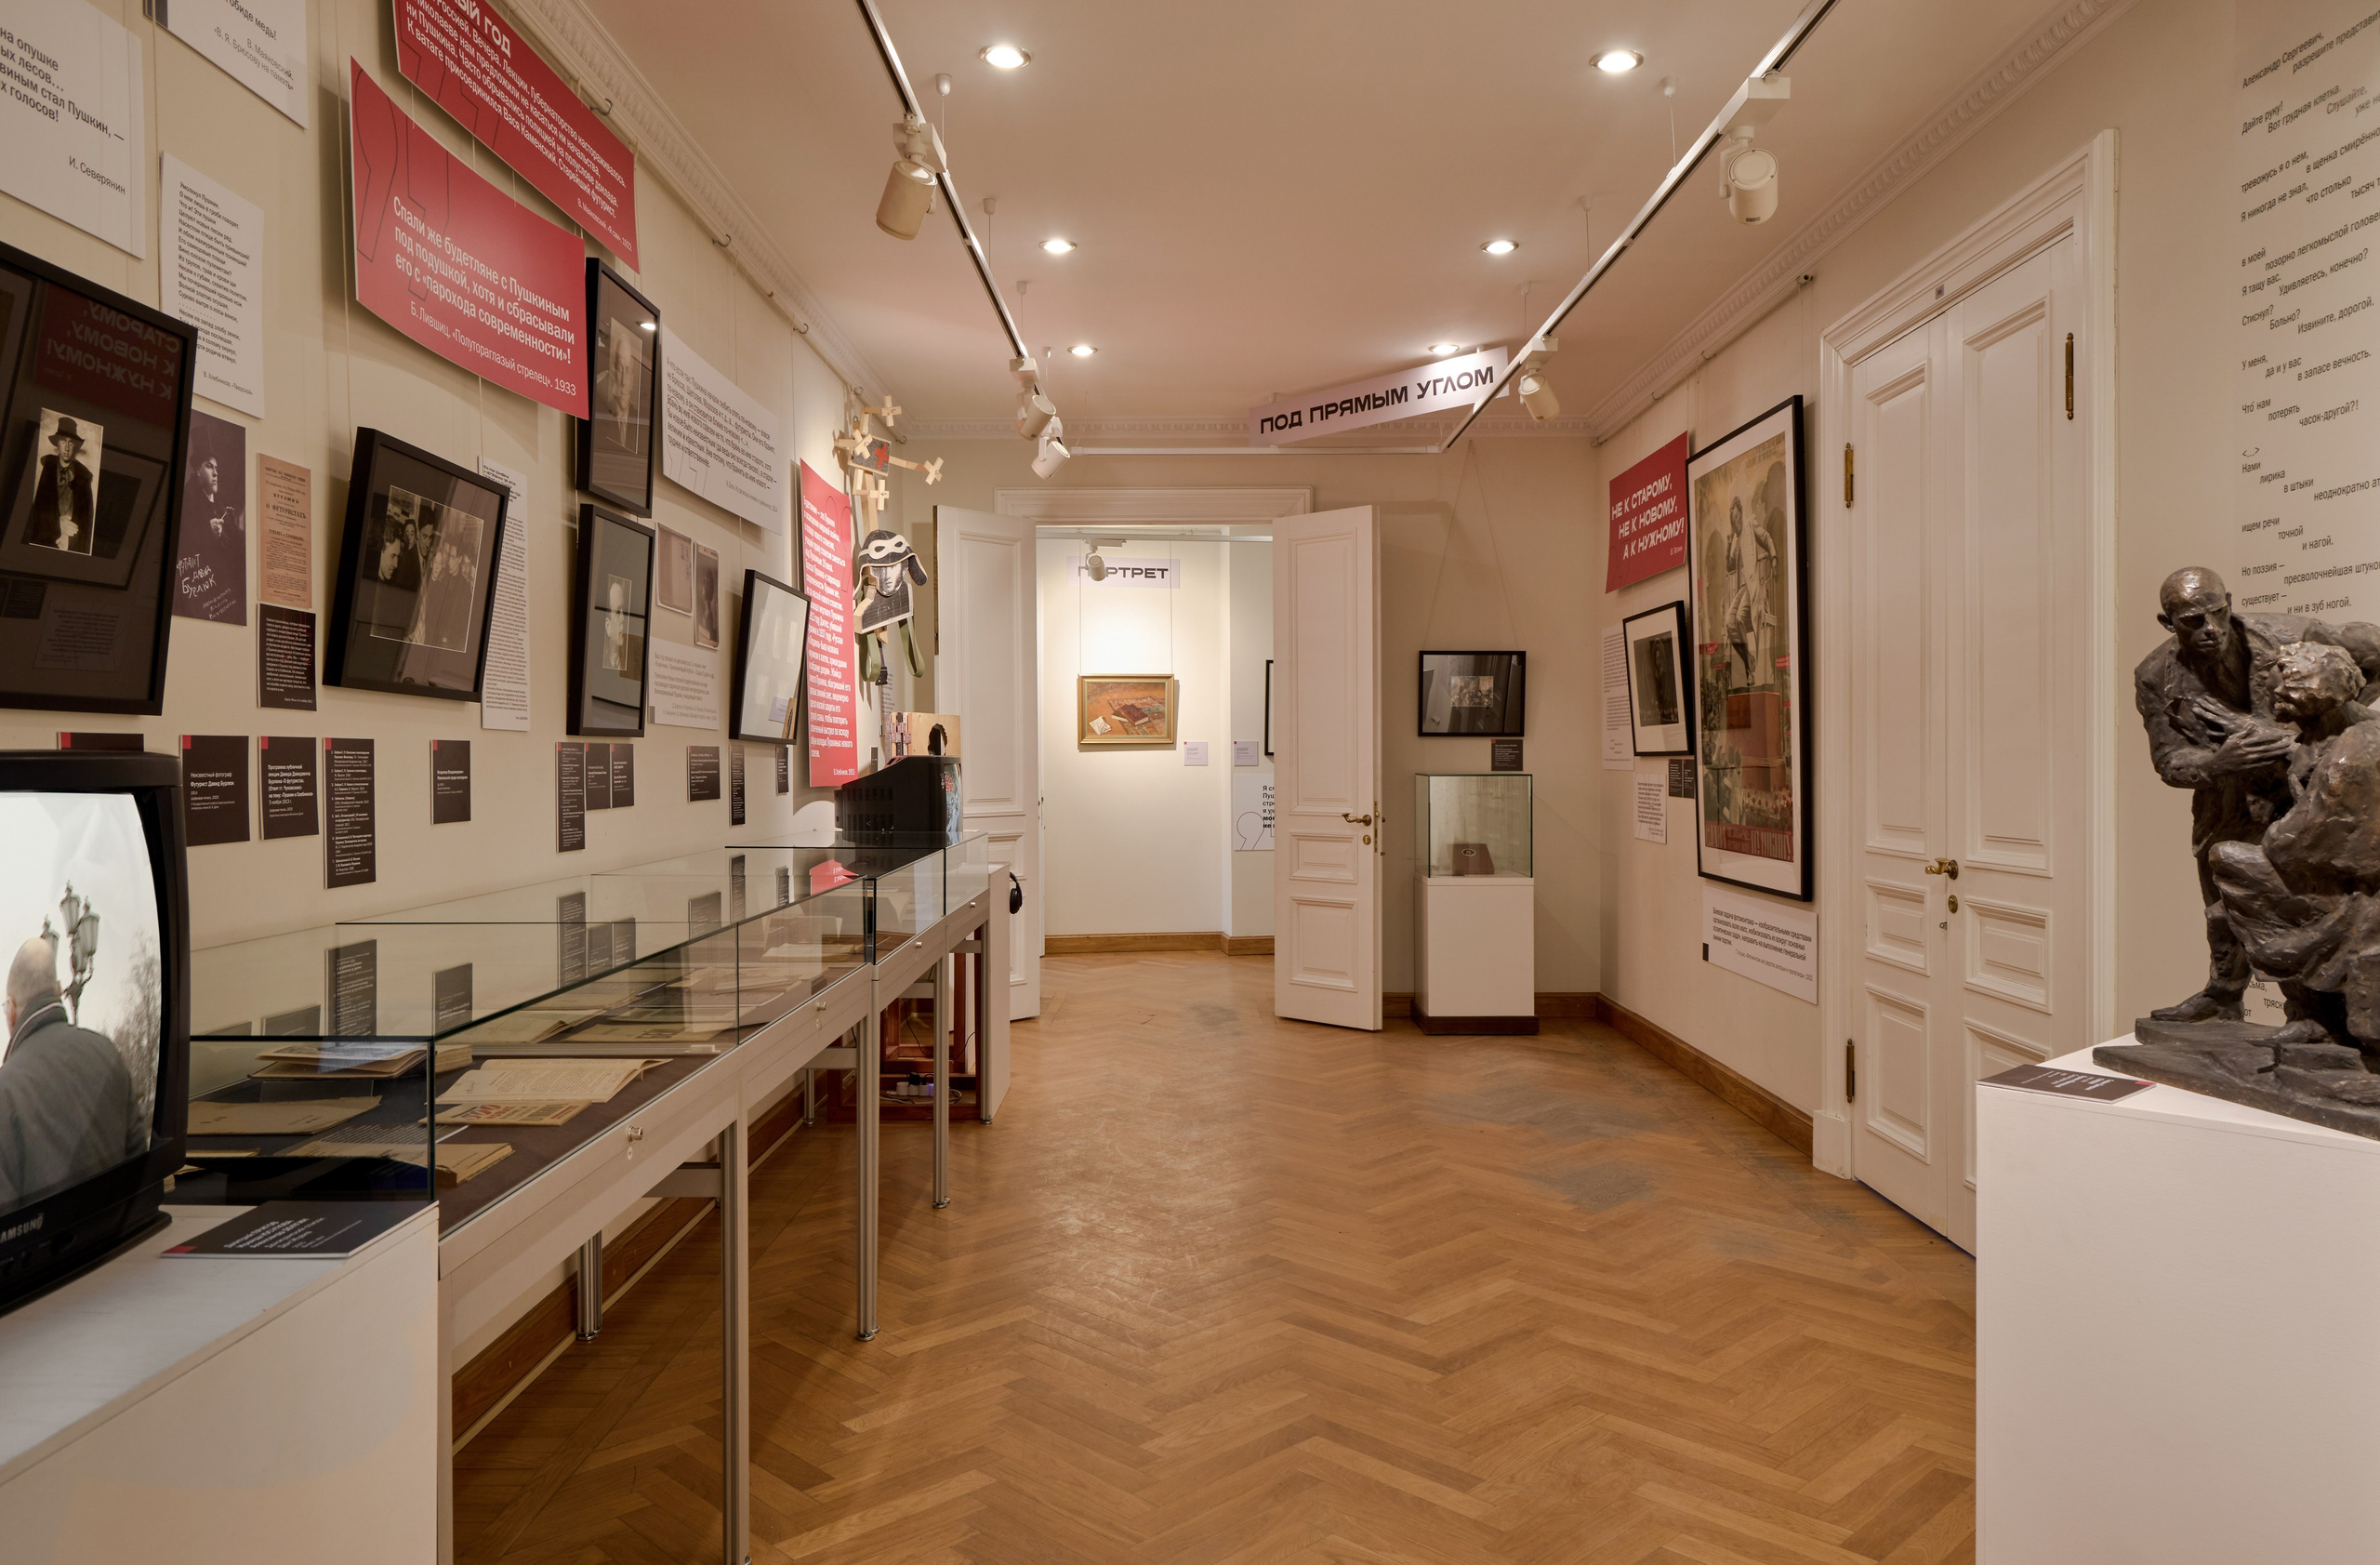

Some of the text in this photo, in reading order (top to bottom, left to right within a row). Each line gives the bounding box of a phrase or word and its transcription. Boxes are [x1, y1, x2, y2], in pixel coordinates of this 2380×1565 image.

[484, 16, 510, 58] ГОД
[17, 38, 59, 71] опушке
[2242, 32, 2324, 89] Александр Сергеевич,
[2293, 40, 2334, 74] разрешите
[9, 86, 59, 122] голосов!
[41, 87, 65, 109] стал
[68, 99, 111, 138] Пушкин,
[2241, 100, 2283, 136] Дайте руку!
[2268, 85, 2341, 133] Вот грудная клетка.
[2241, 151, 2308, 193] тревожусь нем,
[2312, 150, 2337, 170] щенка
[69, 155, 126, 195] И. Северянин
[2320, 175, 2351, 198] столько
[2350, 180, 2374, 199] тысяч
[2247, 182, 2308, 219] никогда знал,
[393, 196, 569, 322] Спали же будетляне с Пушкиным
[2247, 246, 2266, 264] моей
[2265, 223, 2348, 272] позорно легкомыслой
[395, 253, 412, 276] его
[414, 267, 420, 283] с
[2279, 247, 2369, 296] Удивляетесь, конечно?
[395, 226, 575, 345] под подушкой, хотя и сбрасывали
[2248, 273, 2281, 293] тащу вас.
[2241, 304, 2274, 326] Стиснул?
[2269, 308, 2301, 330] Больно?
[2297, 296, 2374, 334] Извините, дорогой.
[410, 300, 418, 318] Б.
[554, 378, 576, 396] 1933
[2248, 354, 2268, 368] меня,
[2304, 350, 2372, 379] запасе вечность.
[1260, 365, 1494, 434] ПОД ПРЯМЫМ УГЛОМ
[2256, 398, 2270, 410] нам
[2268, 405, 2300, 421] потерять
[2299, 399, 2359, 426] часок-другой?!
[2241, 461, 2261, 473] Нами
[2259, 470, 2285, 484] лирика
[1611, 473, 1672, 520] НЕ К СТАРОМУ,
[2290, 478, 2313, 491] штыки
[2313, 480, 2370, 501] неоднократно
[1619, 495, 1677, 539] НЕ К НОВОМУ,
[2241, 517, 2280, 532] ищем речи
[2278, 524, 2304, 539] точной
[1622, 517, 1685, 560] А К НУЖНОМУ!
[2308, 535, 2334, 549] нагой.
[2252, 563, 2277, 575] поэзия
[2283, 565, 2352, 586] пресволочнейшая
[2241, 592, 2280, 608] существует
[2311, 596, 2351, 614] зуб ногой.
